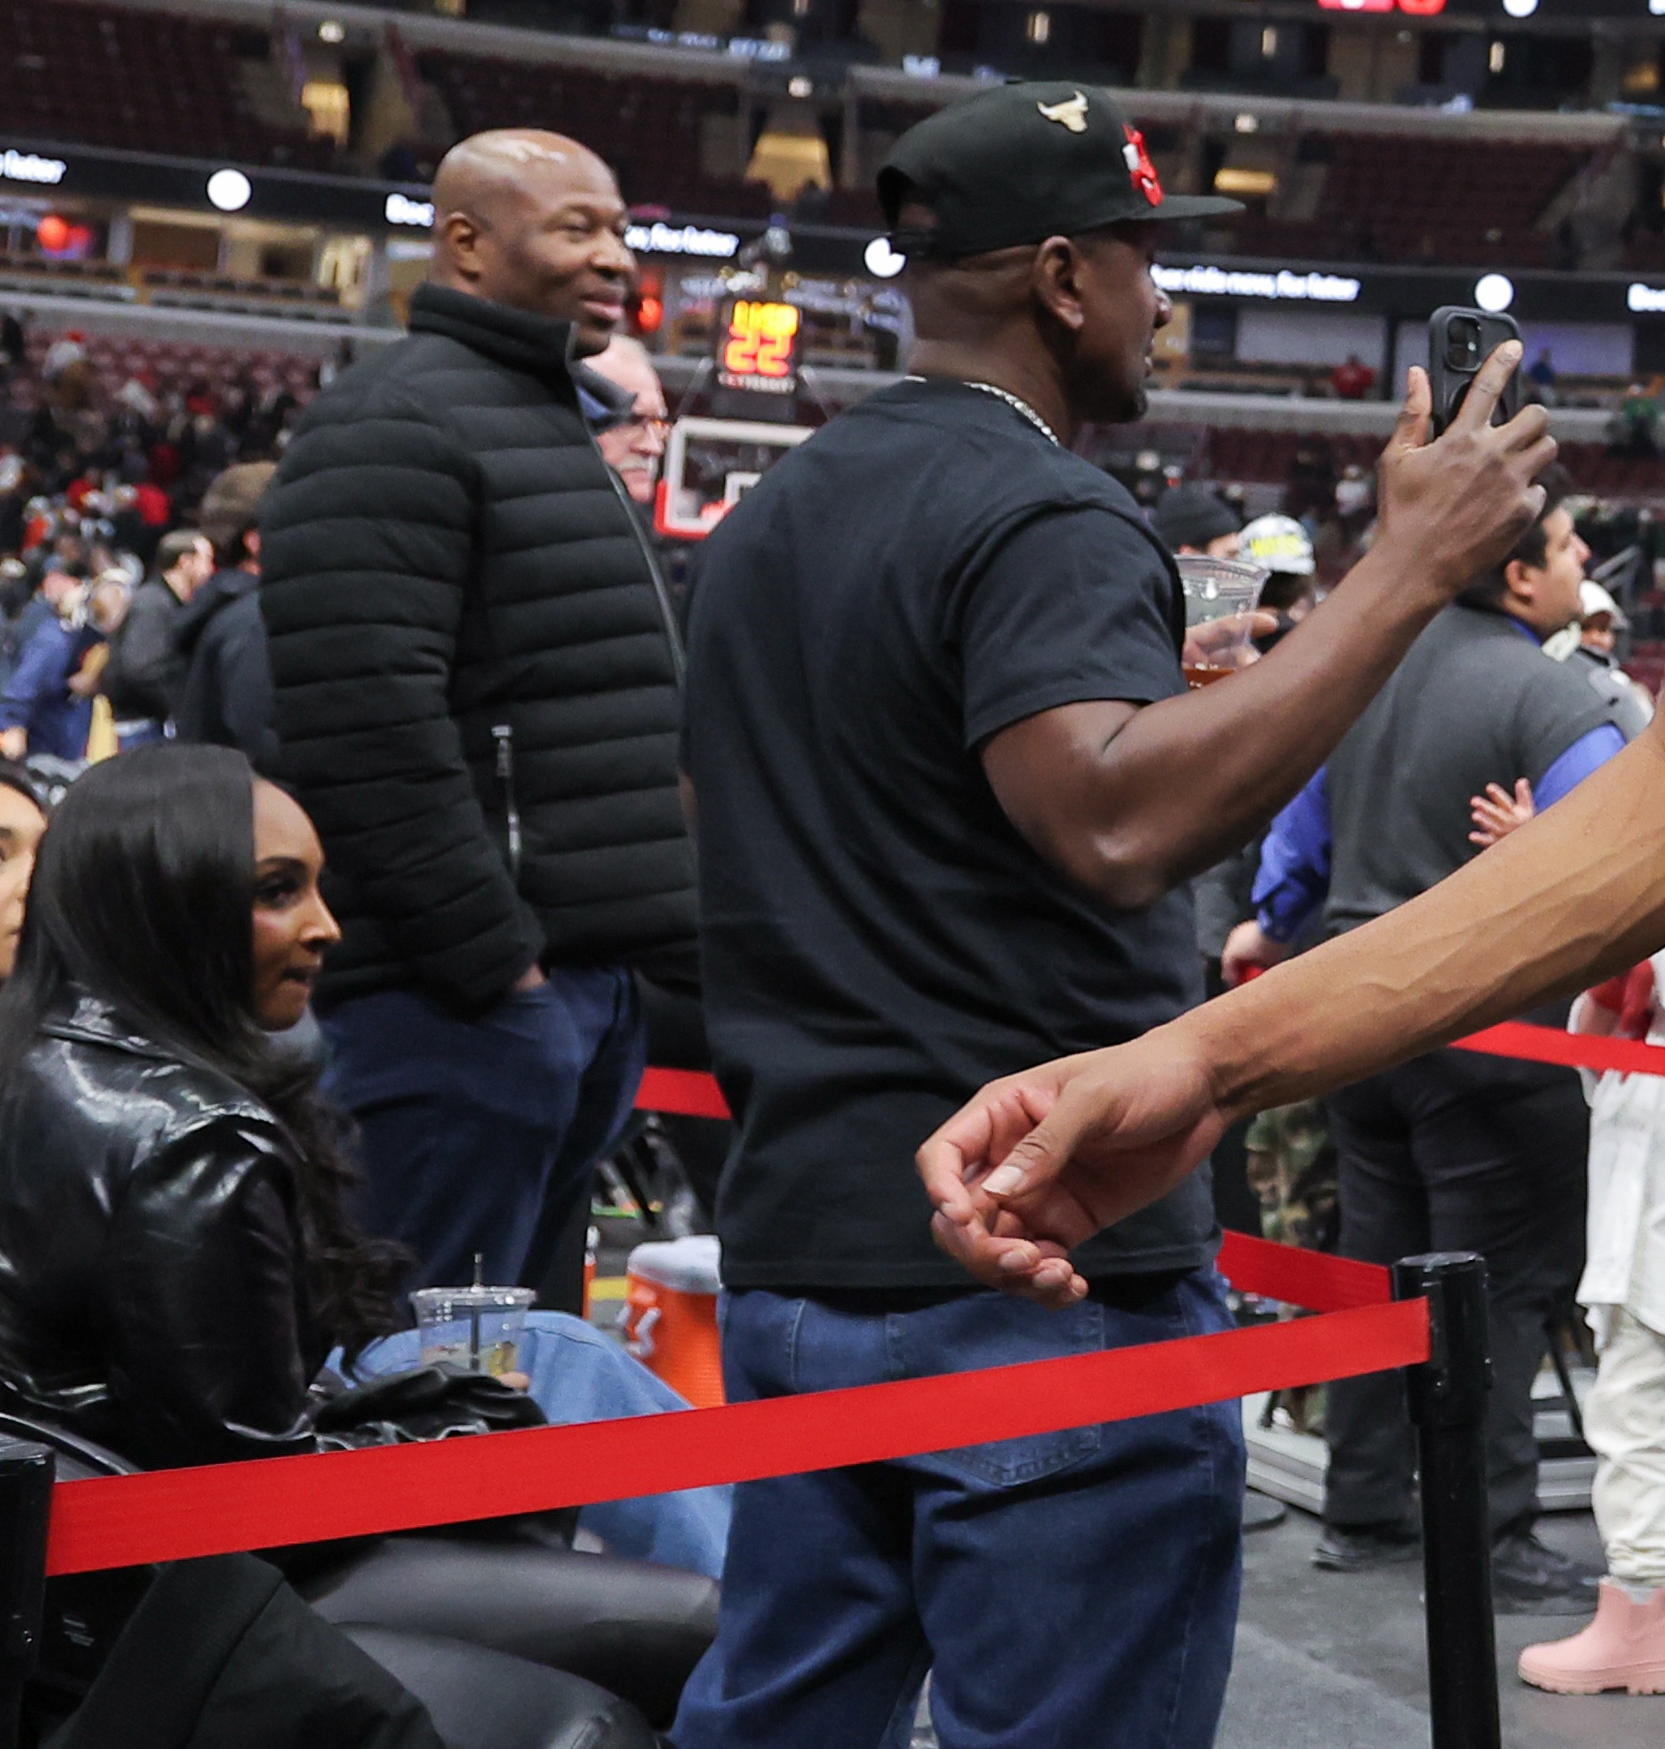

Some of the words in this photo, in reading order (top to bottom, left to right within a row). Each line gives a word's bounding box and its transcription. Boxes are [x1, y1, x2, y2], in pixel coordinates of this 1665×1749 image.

[386, 195, 434, 226] Boo
[1277, 271, 1309, 297] for
[1306, 273, 1358, 300] later
[725, 323, 791, 377] 22
